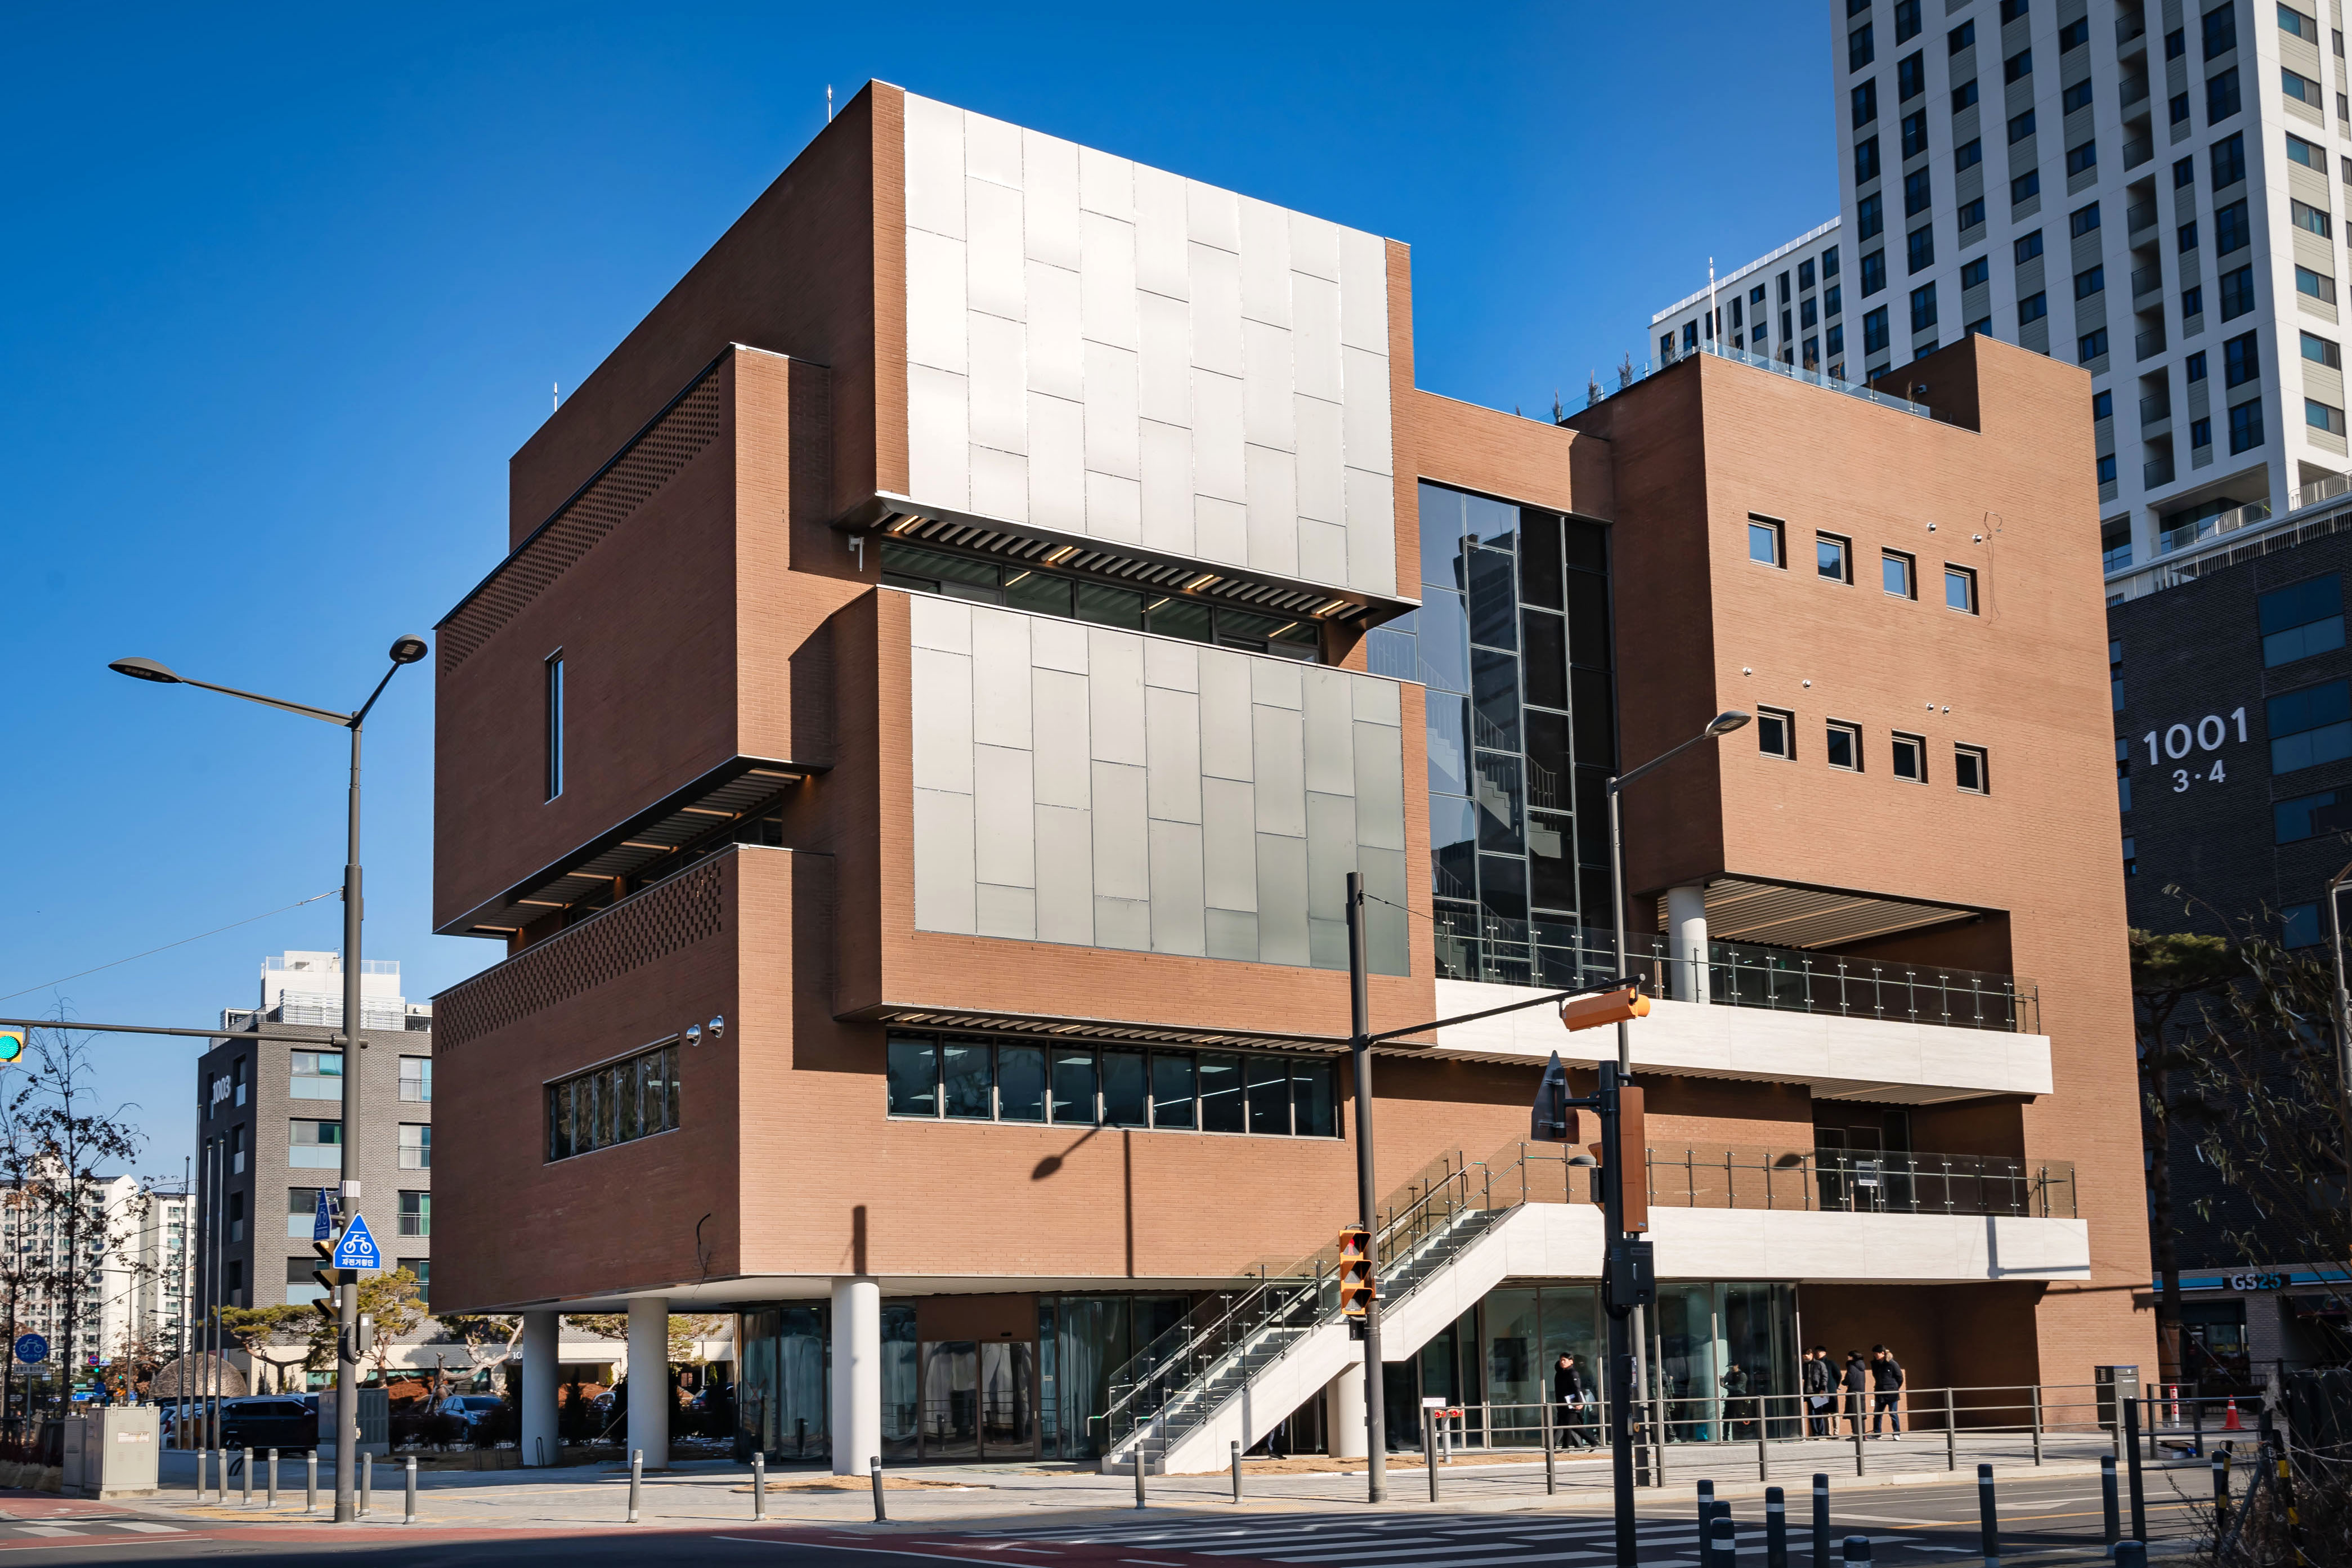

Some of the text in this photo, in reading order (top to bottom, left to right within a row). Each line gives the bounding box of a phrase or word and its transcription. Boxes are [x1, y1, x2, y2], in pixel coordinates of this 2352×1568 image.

[2143, 707, 2248, 765] 1001
[213, 1075, 231, 1104] 1003
[342, 1258, 374, 1267] 자전거횡단
[2230, 1273, 2282, 1291] GS25
